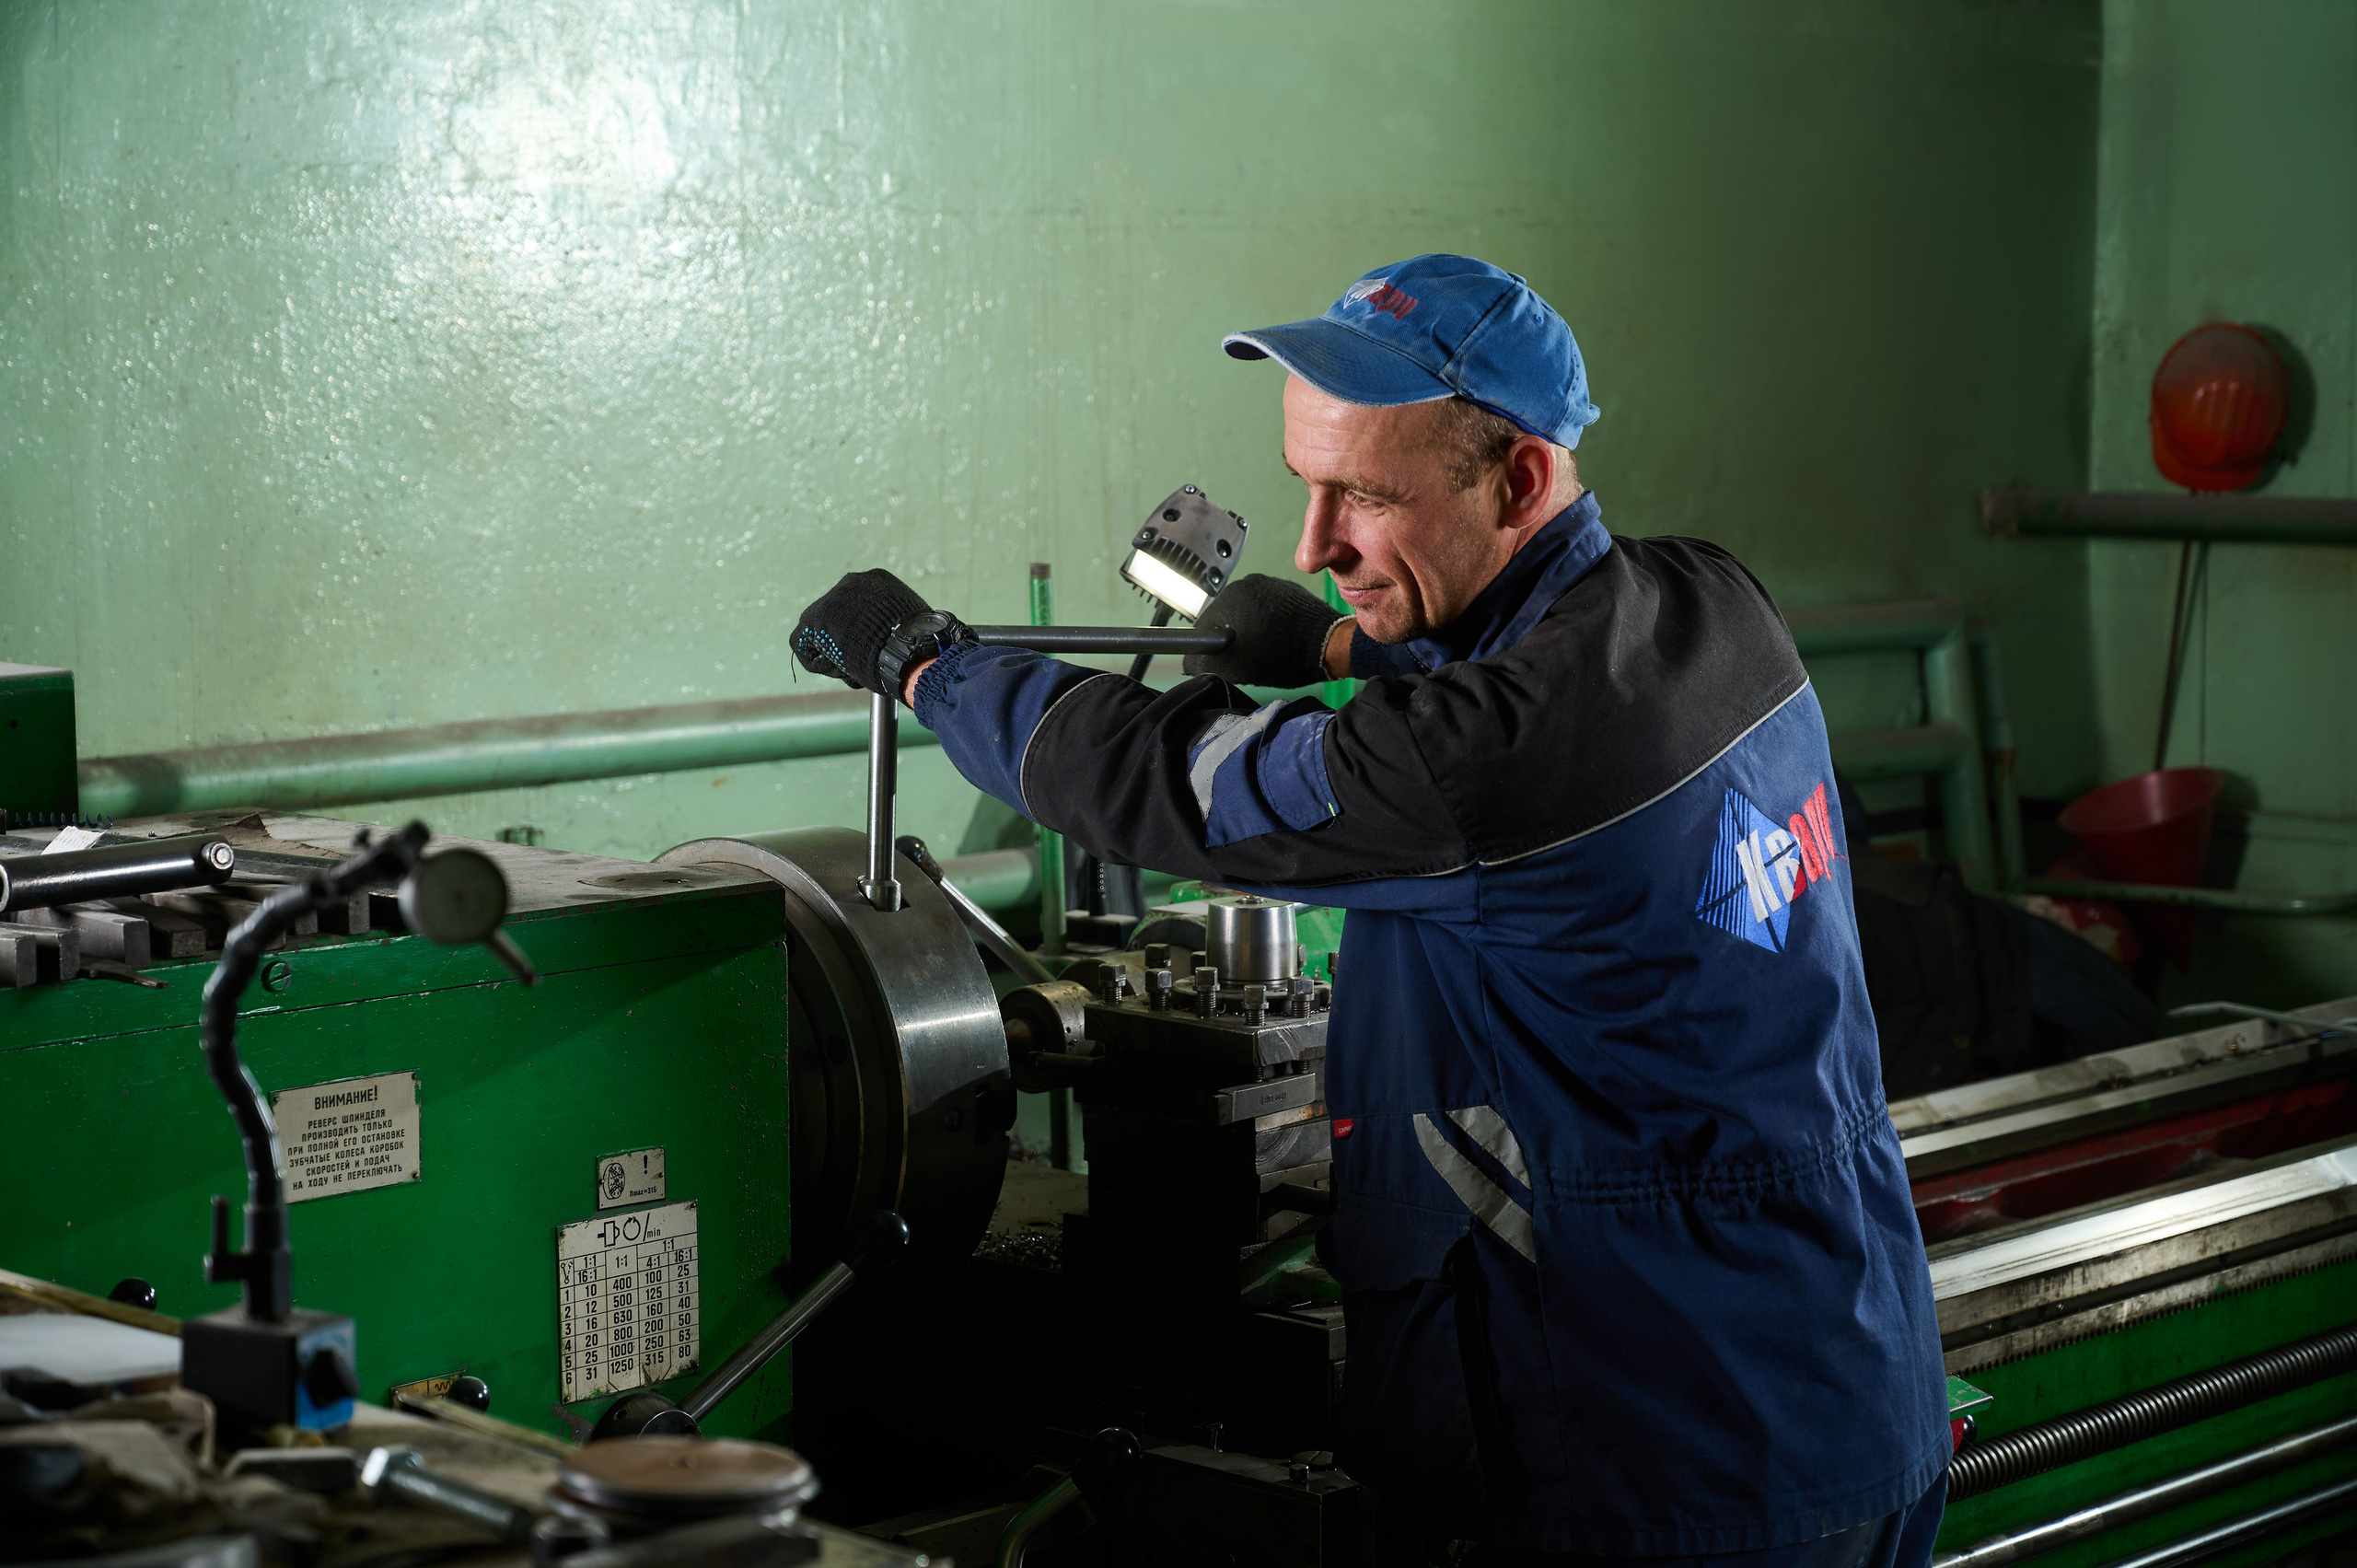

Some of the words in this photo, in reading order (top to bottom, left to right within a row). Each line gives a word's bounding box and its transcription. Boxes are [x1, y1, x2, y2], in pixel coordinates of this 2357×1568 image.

[315, 1085, 377, 1110] ВНИМАНИЕ!
[302, 1125, 358, 1143] ПРОИЗВОДИТЬ
[363, 1119, 392, 1132] ТОЛЬКО
[308, 1117, 337, 1130] РЕВЕРС
[343, 1109, 386, 1123] ШПИНДЕЛЯ
[288, 1145, 303, 1156] ПРИ
[308, 1138, 339, 1153] ПОЛНОЙ
[343, 1137, 357, 1147] ЕГО
[362, 1129, 405, 1144] ОСТАНОВКЕ
[289, 1153, 331, 1167] ЗУБЧАТЫЕ
[335, 1147, 365, 1159] КОЛЕСА
[370, 1141, 404, 1154] КОРОБОК
[293, 1180, 302, 1191] НА
[308, 1176, 328, 1188] ХОДУ
[333, 1173, 342, 1183] НЕ
[347, 1164, 402, 1180] ПЕРЕКЛЮЧАТЬ
[306, 1160, 350, 1177] СКОРОСТЕЙ
[365, 1155, 389, 1166] ПОДАЧ
[663, 1238, 674, 1252] 1:1
[675, 1249, 692, 1262] 16:1
[584, 1255, 597, 1268] 1:1
[616, 1255, 627, 1268] 1:1
[646, 1255, 660, 1268] 4:1
[565, 1290, 569, 1302] 1
[586, 1284, 597, 1297] 10
[613, 1276, 632, 1291] 400
[645, 1270, 661, 1284] 100
[678, 1264, 690, 1277] 25
[578, 1269, 597, 1283] 16:1
[565, 1307, 571, 1318] 2
[586, 1301, 597, 1314] 12
[613, 1293, 632, 1307] 500
[645, 1286, 662, 1301] 125
[679, 1281, 689, 1294] 31
[565, 1323, 571, 1335] 3
[586, 1318, 597, 1330] 16
[614, 1309, 632, 1324] 630
[646, 1302, 662, 1317] 160
[679, 1296, 690, 1309] 40
[565, 1340, 571, 1352] 4
[586, 1334, 598, 1347] 20
[614, 1326, 633, 1341] 800
[645, 1319, 663, 1333] 200
[679, 1313, 691, 1326] 50
[565, 1356, 571, 1368] 5
[586, 1351, 598, 1364] 25
[610, 1342, 633, 1358] 1000
[645, 1335, 663, 1350] 250
[679, 1329, 691, 1342] 63
[566, 1373, 572, 1385] 6
[586, 1366, 597, 1380] 31
[610, 1358, 633, 1374] 1250
[645, 1352, 663, 1366] 315
[679, 1345, 691, 1358] 80
